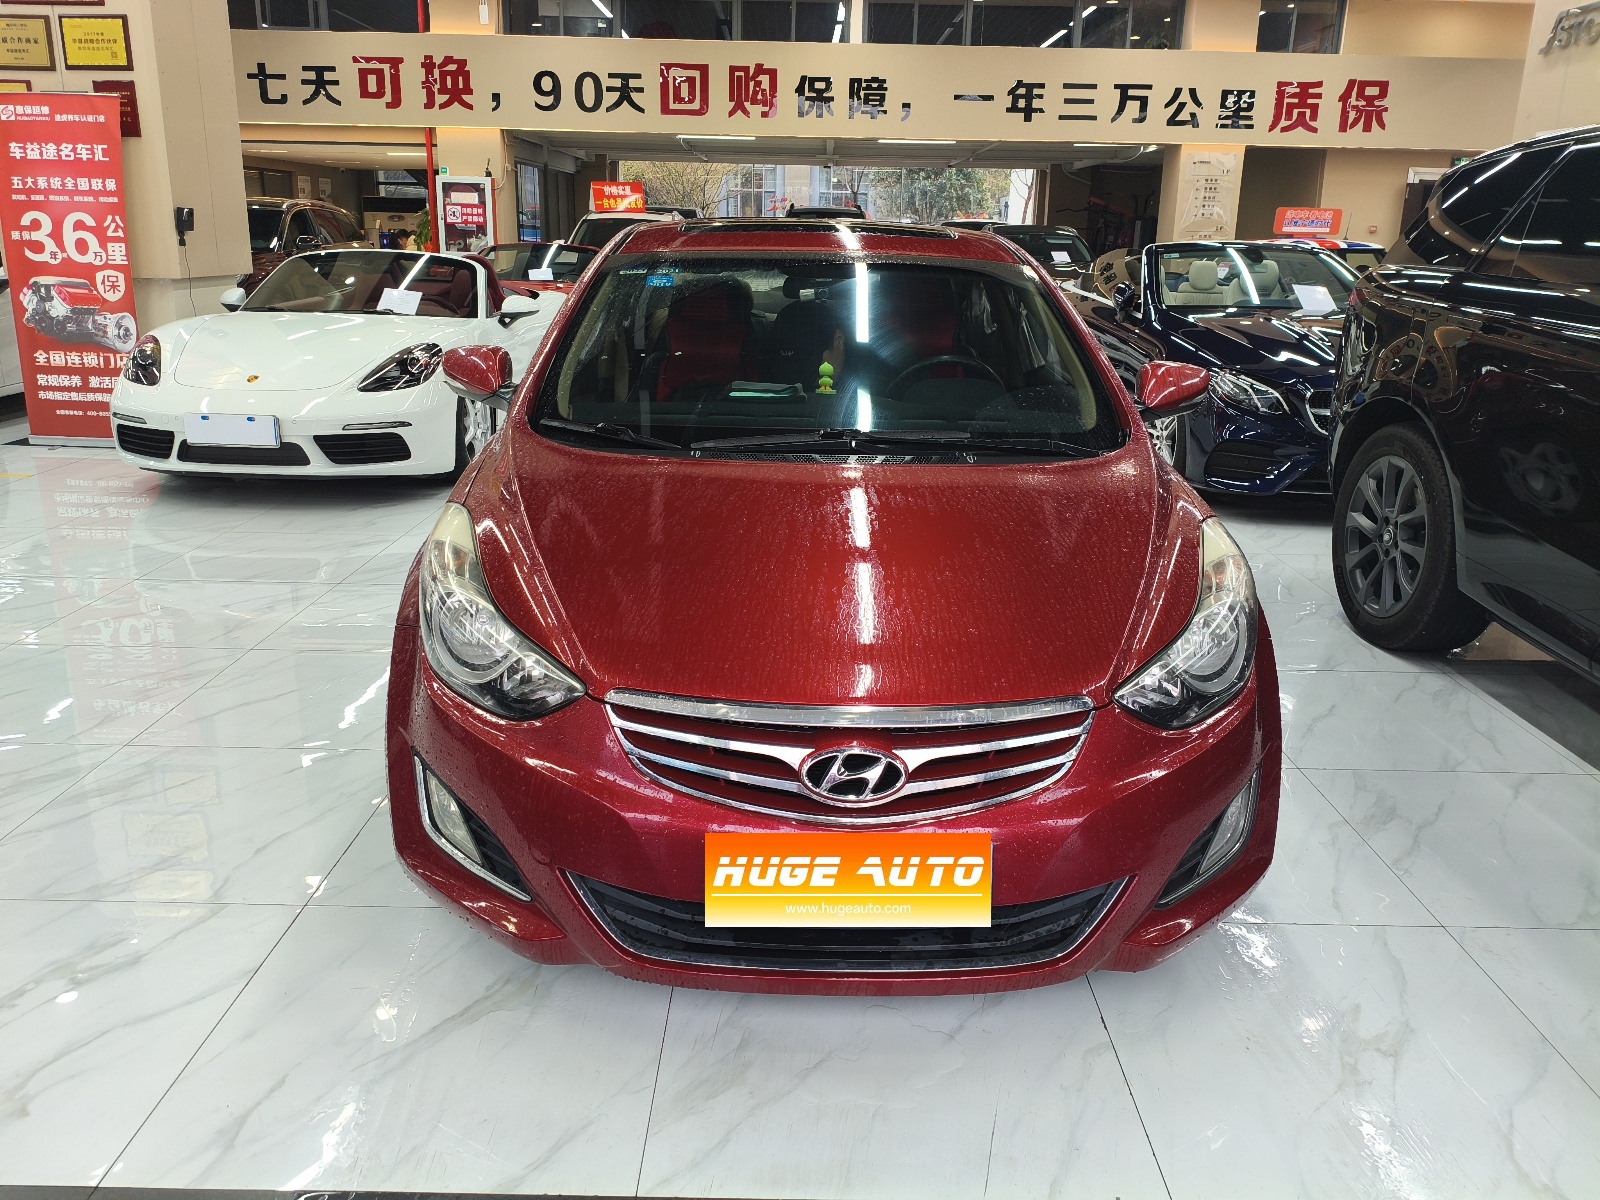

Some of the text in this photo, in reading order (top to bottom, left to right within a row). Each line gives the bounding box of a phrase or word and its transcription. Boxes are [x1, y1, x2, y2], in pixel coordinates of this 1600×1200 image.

[15, 105, 50, 115] 惠保延修
[8, 141, 110, 162] 车益途名车汇
[10, 176, 117, 192] 五大系统全国联保
[100, 274, 122, 295] 保
[37, 374, 83, 388] 常规保养
